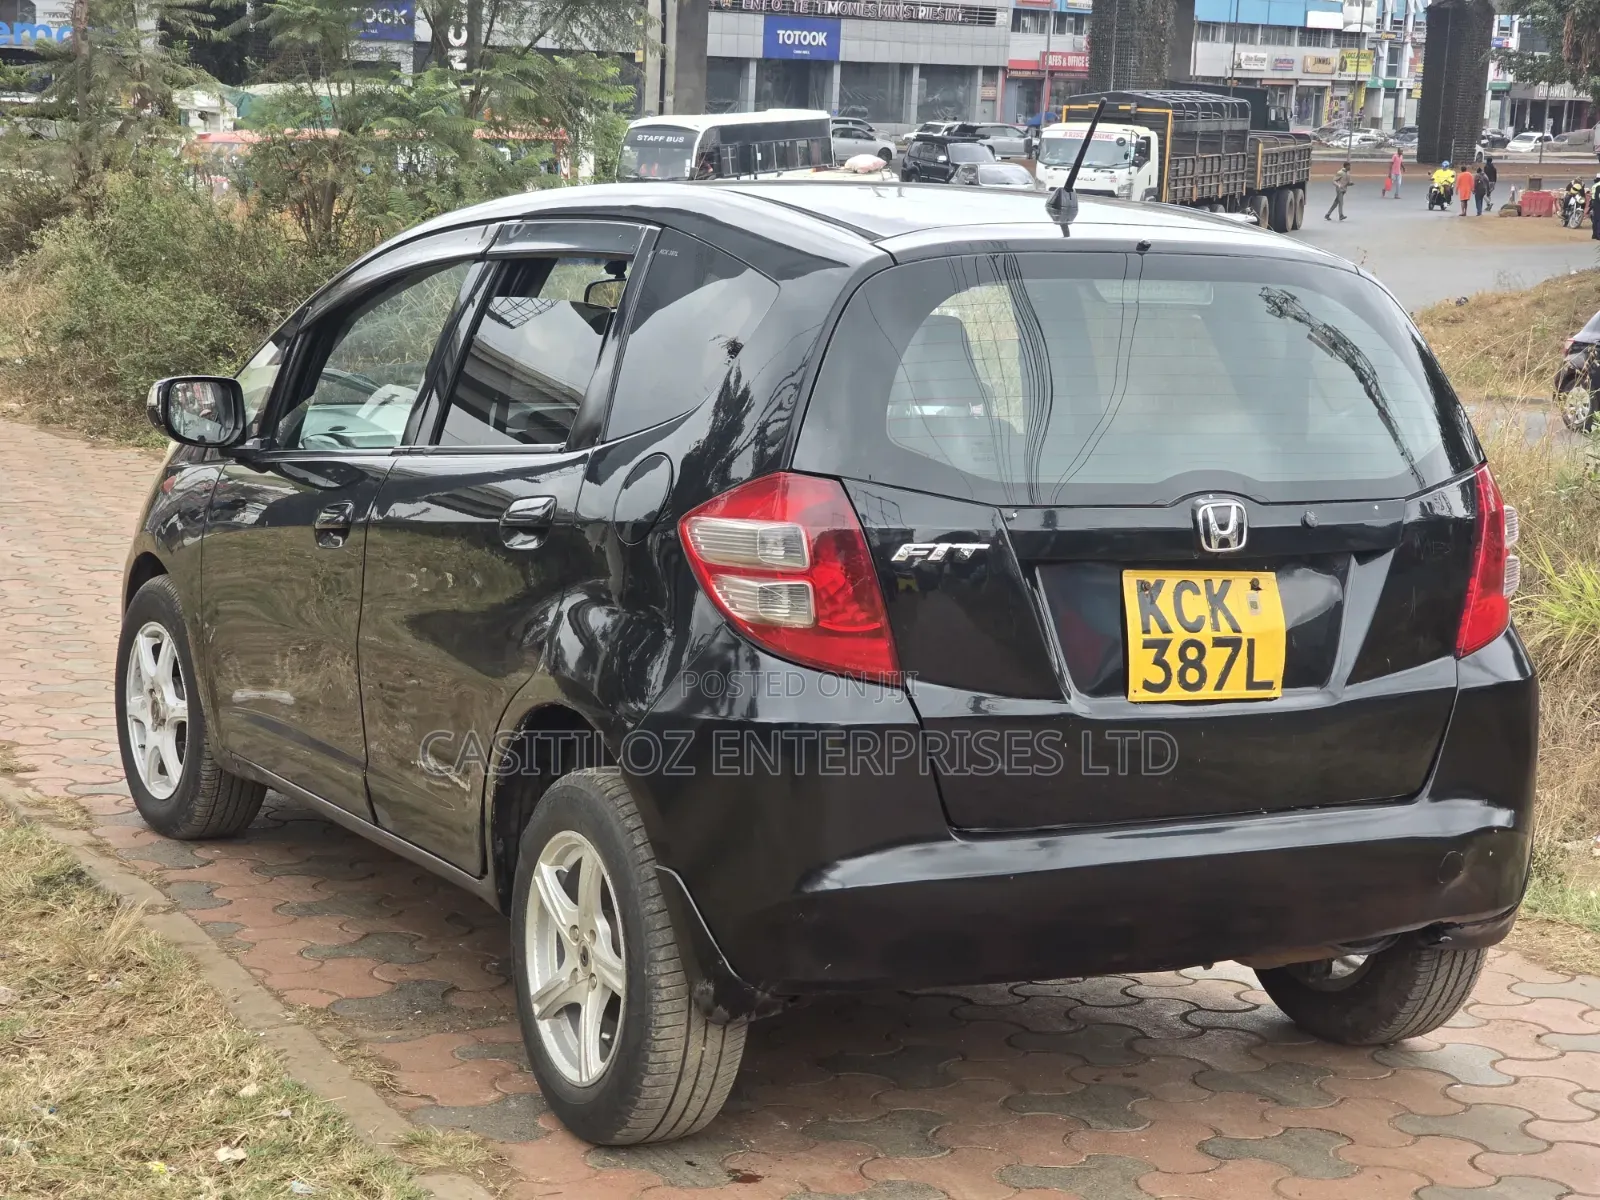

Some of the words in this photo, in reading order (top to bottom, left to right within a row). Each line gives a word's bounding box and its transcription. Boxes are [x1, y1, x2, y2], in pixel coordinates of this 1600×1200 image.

[777, 30, 827, 46] TOTOOK
[1067, 55, 1085, 67] OFFICE
[636, 134, 664, 142] STAFF
[890, 542, 991, 562] FIT
[1136, 578, 1242, 635] KCK
[1142, 637, 1276, 693] 387L
